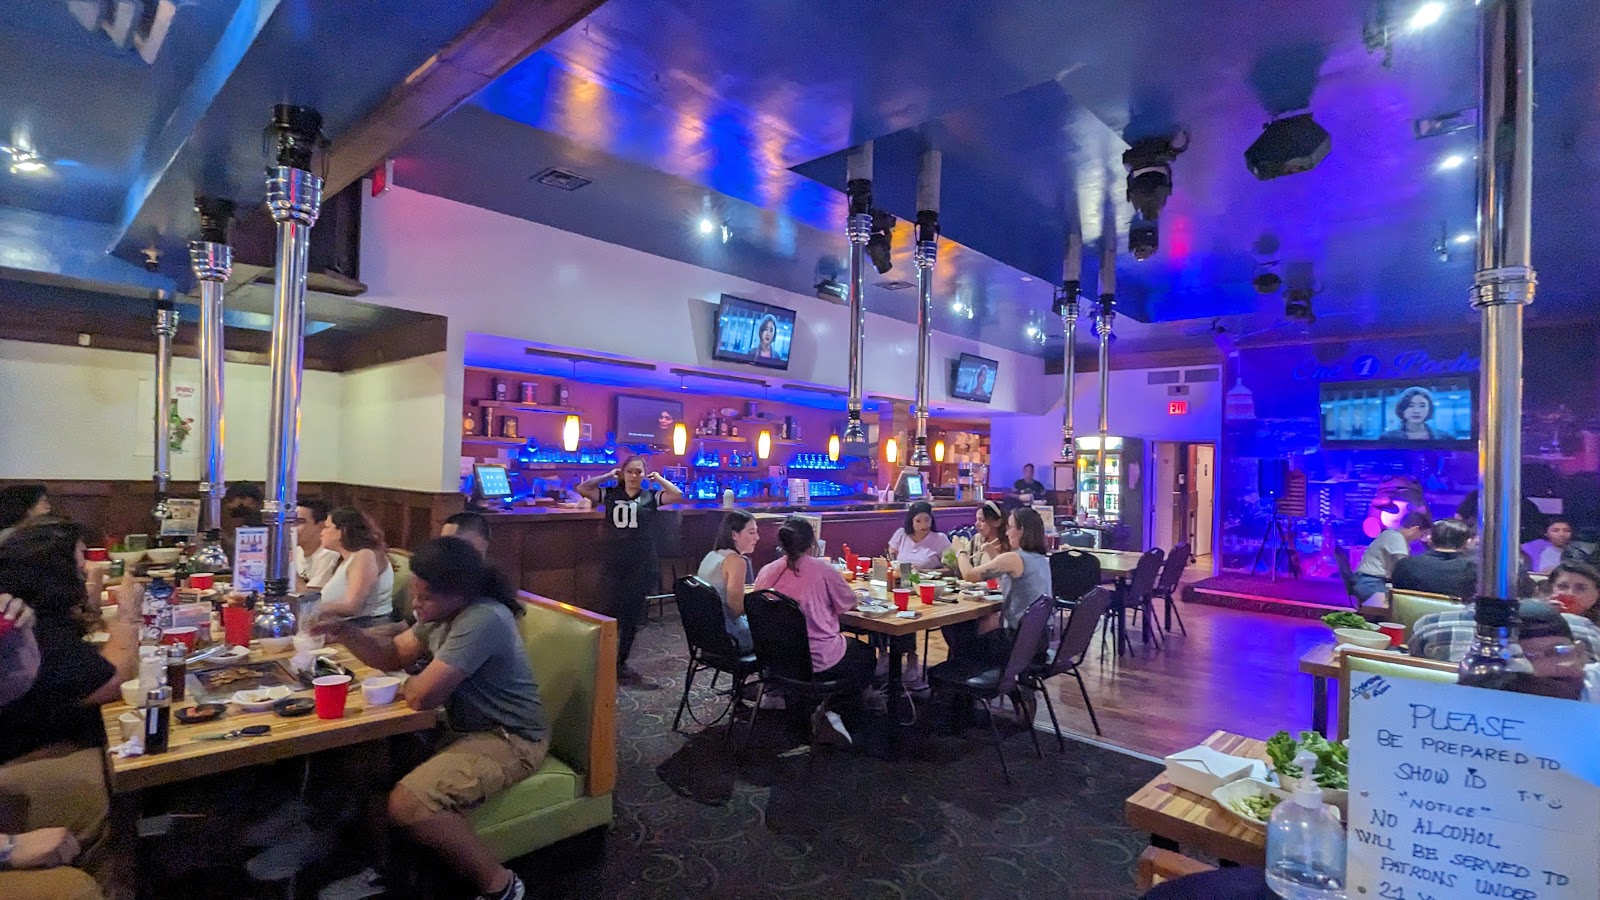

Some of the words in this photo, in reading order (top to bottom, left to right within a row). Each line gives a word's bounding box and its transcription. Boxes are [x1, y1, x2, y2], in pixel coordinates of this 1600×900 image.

[1170, 402, 1186, 414] EXIT
[613, 501, 638, 529] 01
[1409, 703, 1525, 741] PLEASE
[1377, 729, 1403, 748] BE
[1421, 737, 1528, 765] PREPARED
[1536, 756, 1561, 771] TO
[1394, 763, 1448, 785] SHOW
[1370, 809, 1398, 828] NO
[1412, 817, 1501, 849] ALCOHOL
[1355, 828, 1396, 851] WILL
[1412, 843, 1439, 860] BE
[1449, 854, 1530, 878] SERVED
[1542, 870, 1569, 886] TO
[1381, 856, 1458, 888] PATRONS
[1475, 879, 1537, 900] UNDER
